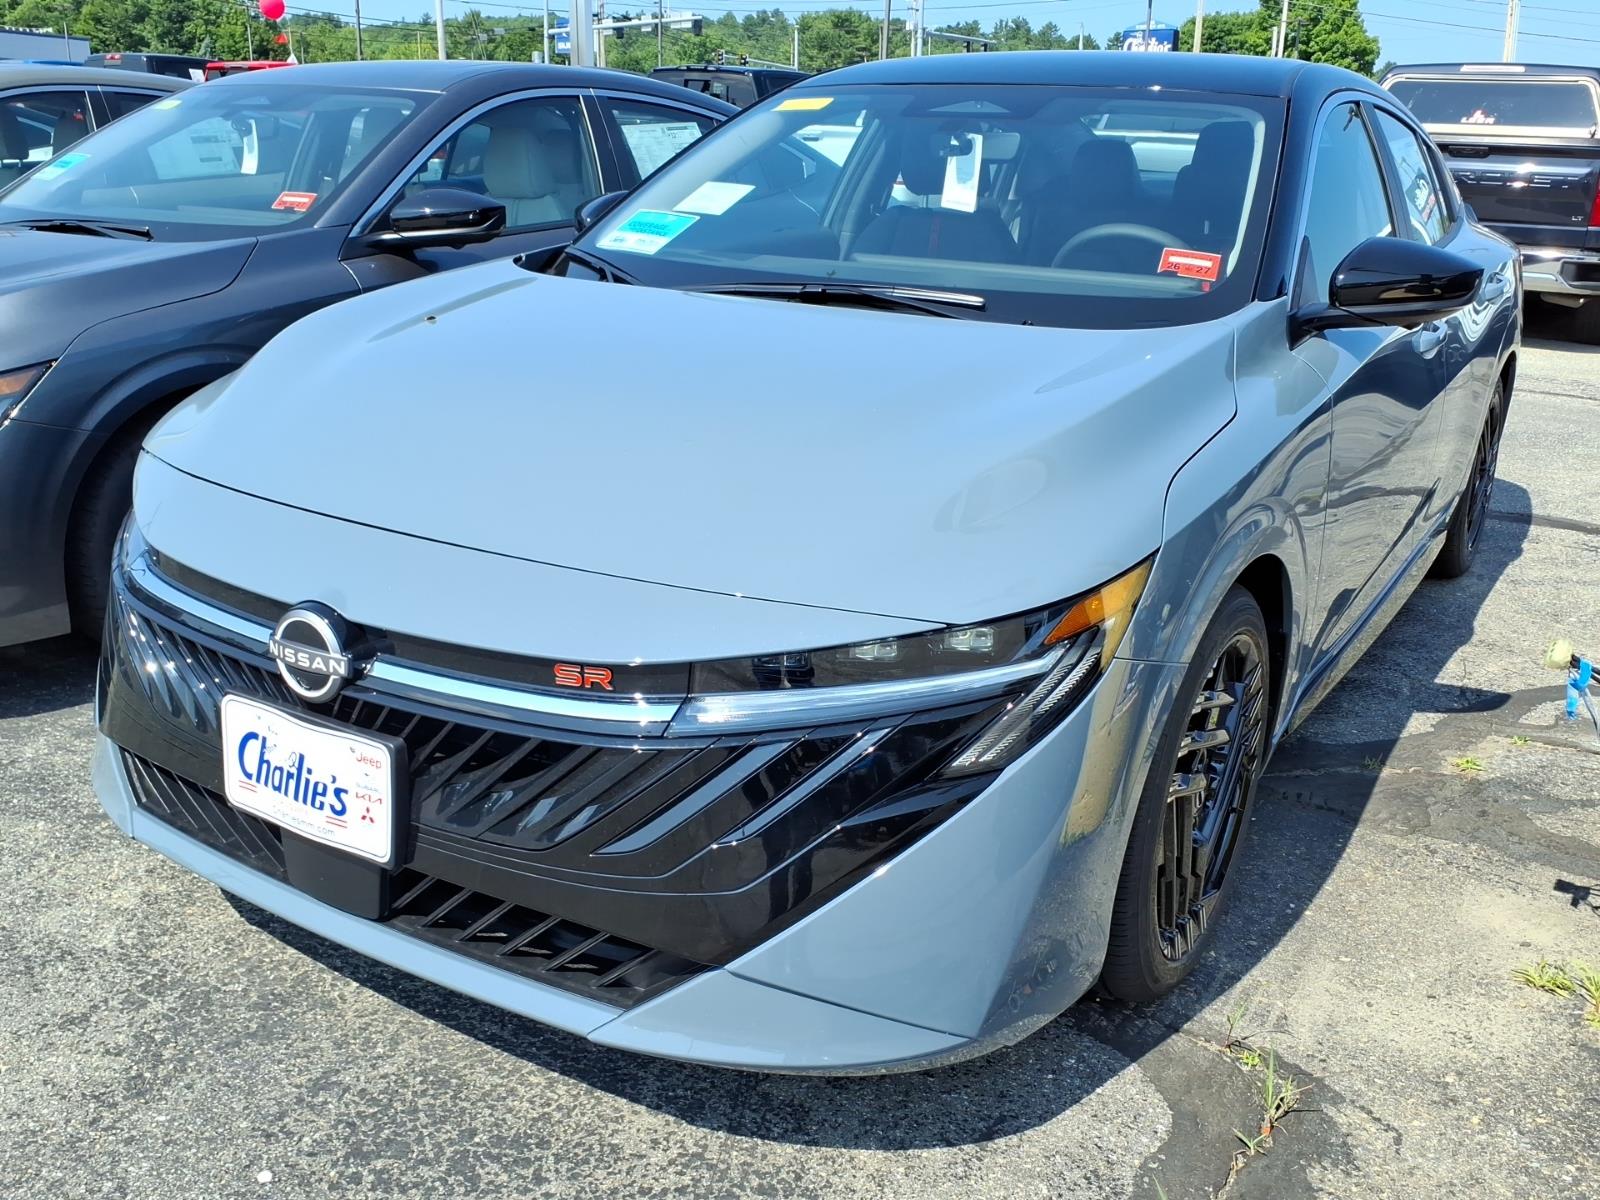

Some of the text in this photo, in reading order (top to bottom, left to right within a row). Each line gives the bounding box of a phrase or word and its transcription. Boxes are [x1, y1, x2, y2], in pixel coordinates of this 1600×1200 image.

[1167, 262, 1180, 270] 26
[1196, 266, 1211, 275] 27
[269, 640, 345, 674] NISSAN
[554, 663, 614, 691] SR
[238, 731, 349, 817] Charlie's
[356, 752, 382, 769] Jeep
